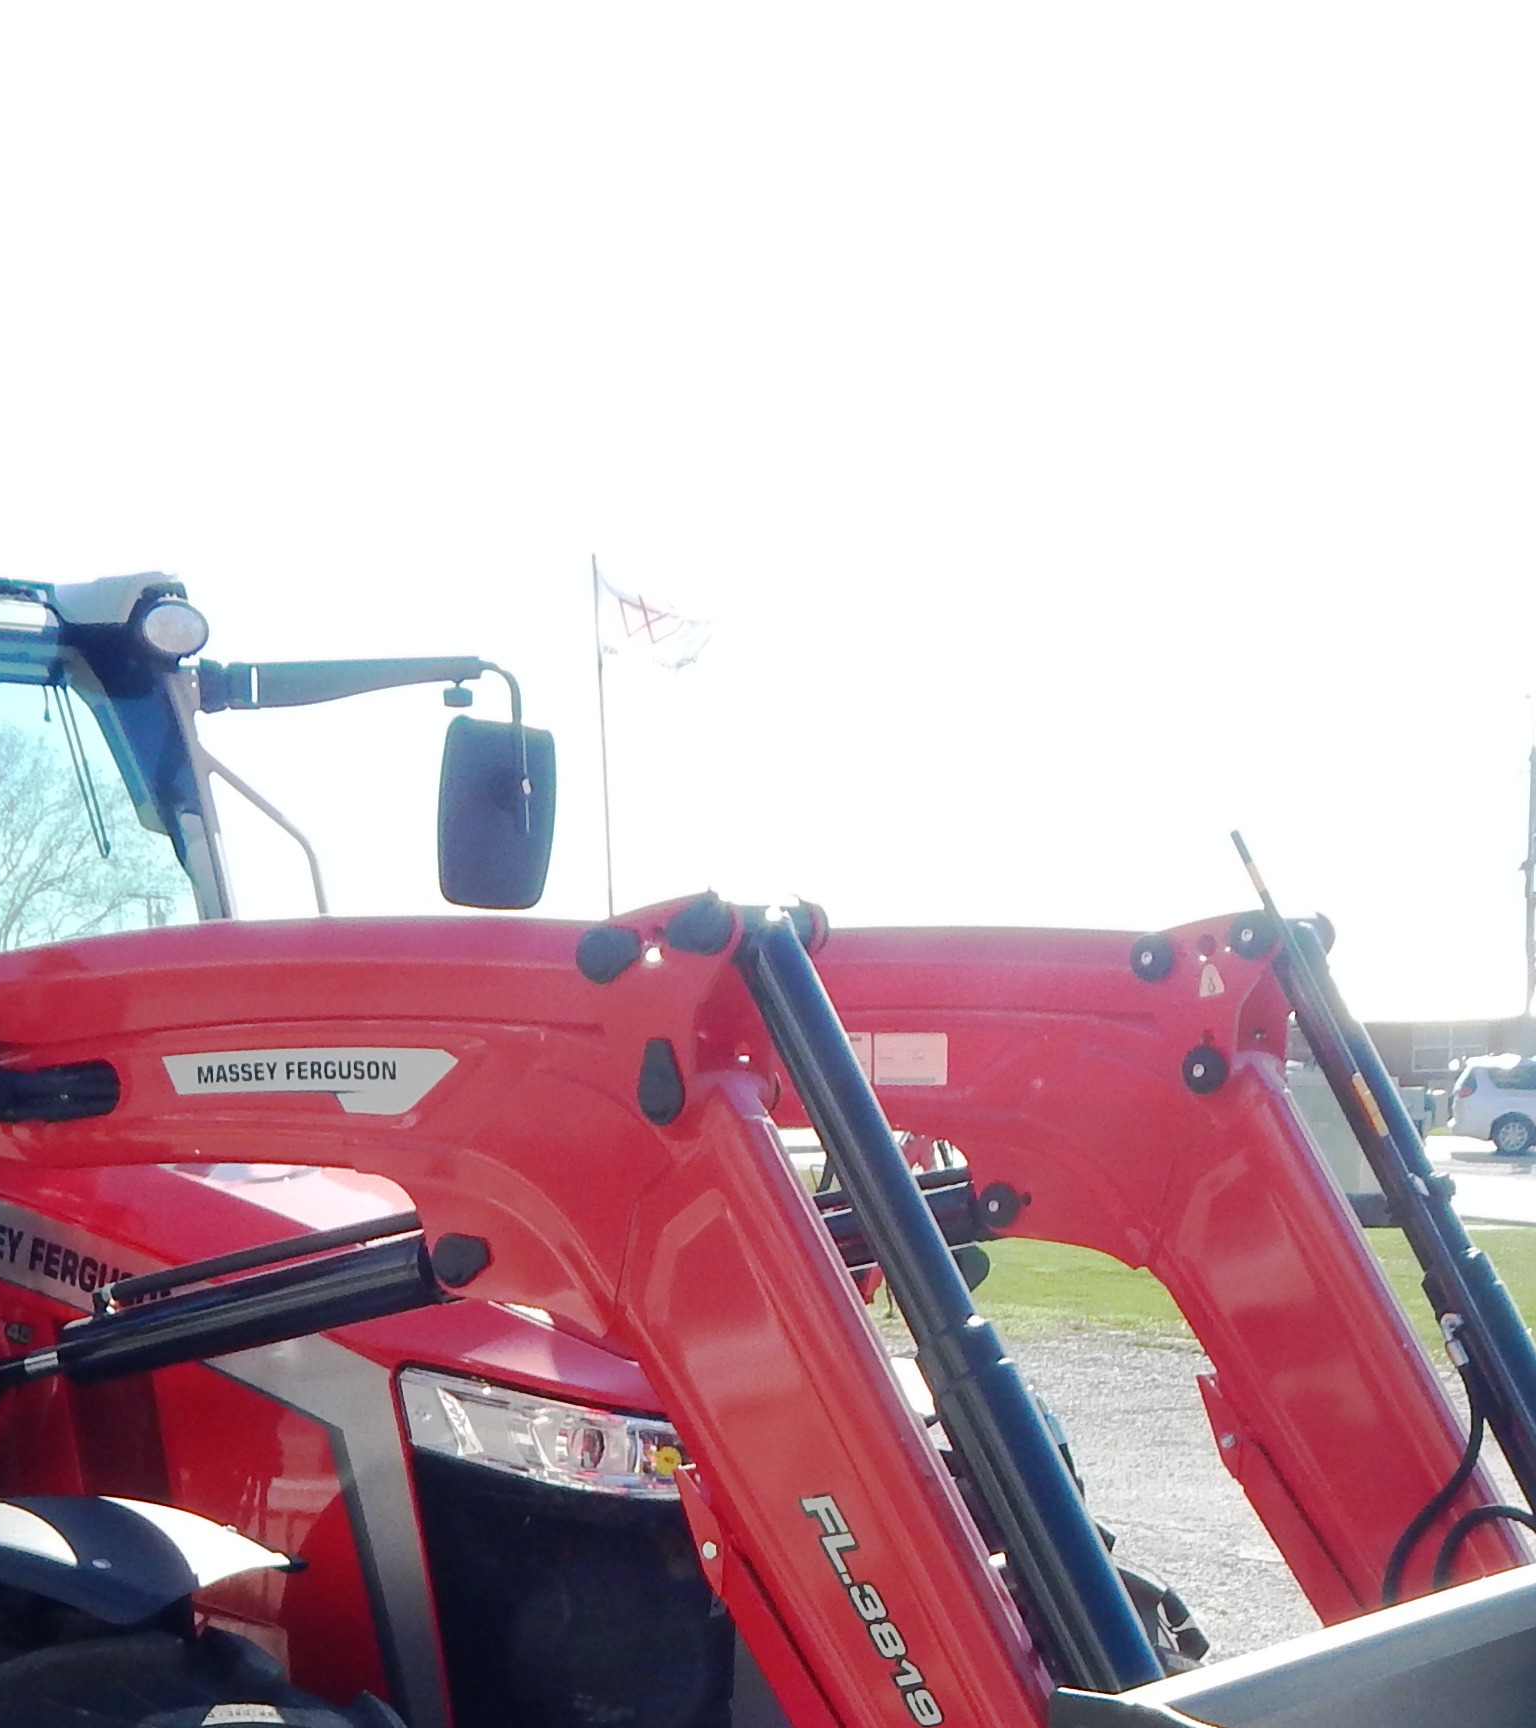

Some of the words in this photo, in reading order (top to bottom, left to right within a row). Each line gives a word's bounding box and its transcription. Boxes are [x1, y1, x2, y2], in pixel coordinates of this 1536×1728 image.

[197, 1061, 277, 1084] MASSEY
[286, 1060, 397, 1081] FERGUSON
[799, 1495, 945, 1727] FL.3819
